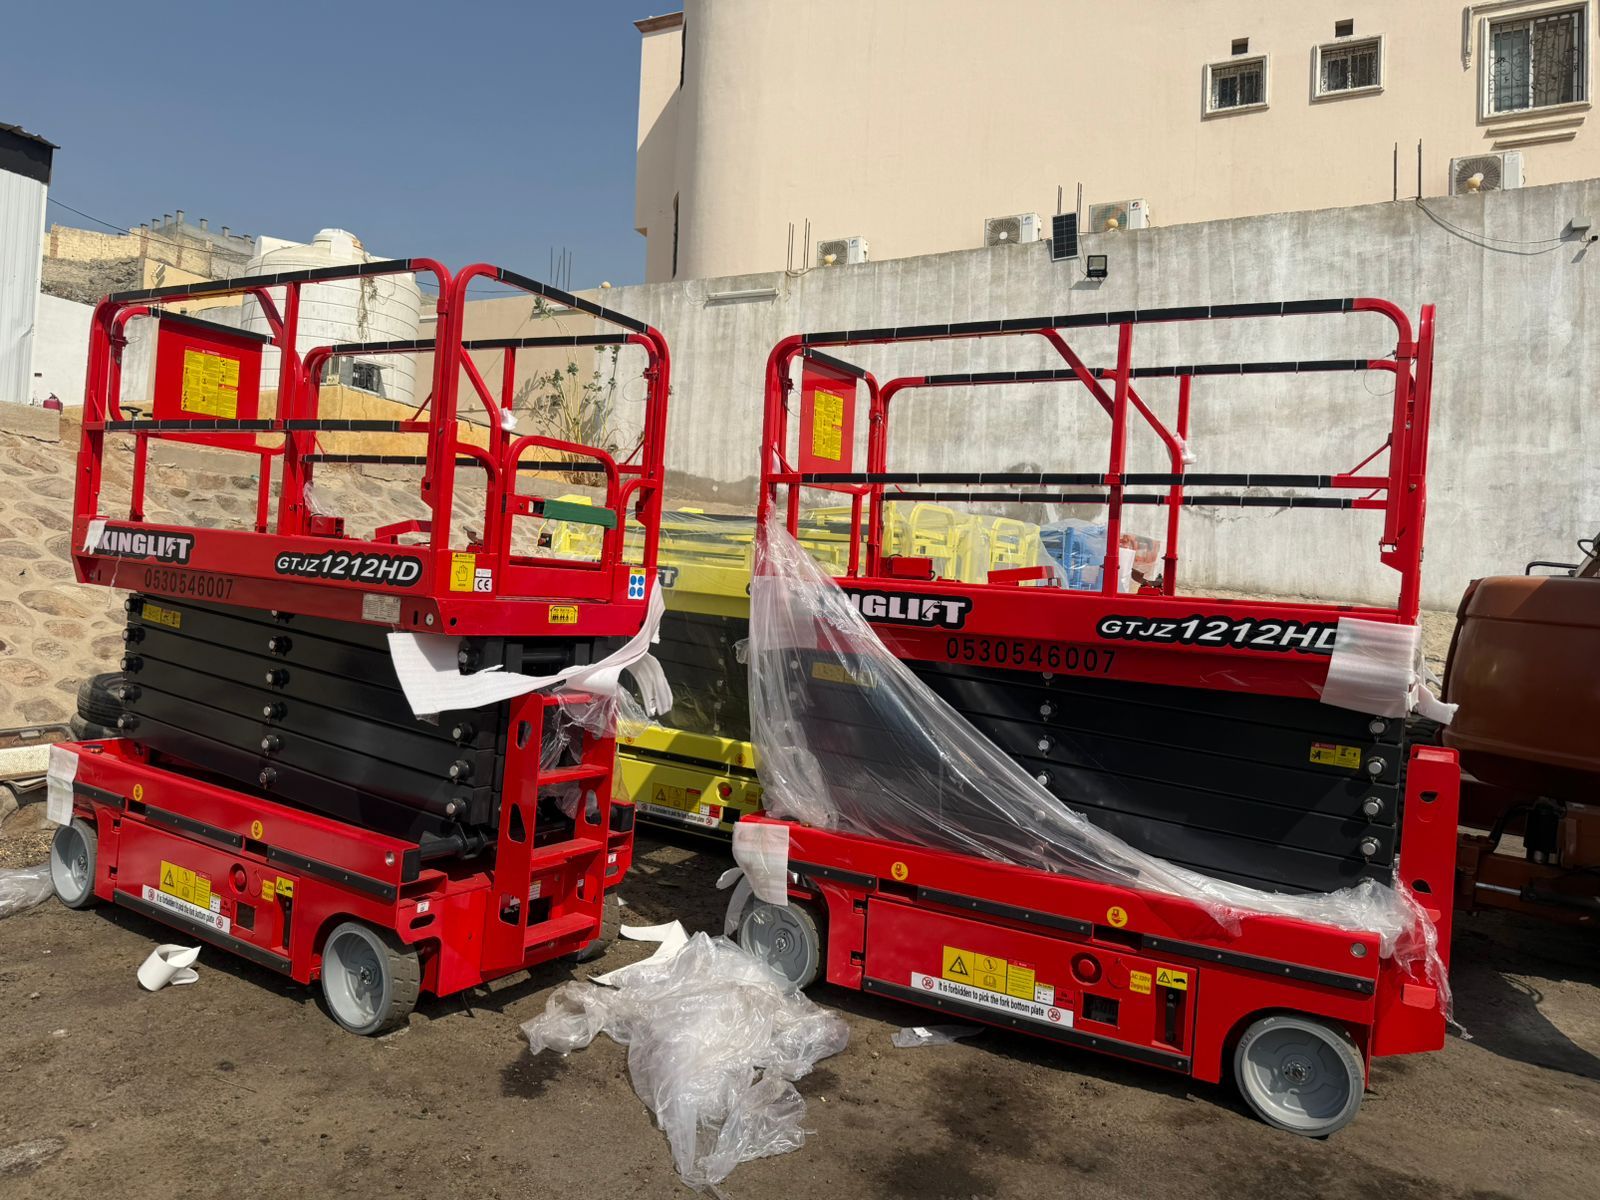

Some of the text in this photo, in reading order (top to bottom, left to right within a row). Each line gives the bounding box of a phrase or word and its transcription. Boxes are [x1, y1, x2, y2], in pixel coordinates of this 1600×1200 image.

[98, 530, 191, 560] KINGLIFT
[277, 554, 419, 581] GTJZ1212HD
[144, 568, 233, 599] 0530546007
[476, 579, 490, 591] CE
[946, 637, 1116, 674] 0530546007
[938, 981, 1045, 1017] It is forbidden to pick the fork bottom plate
